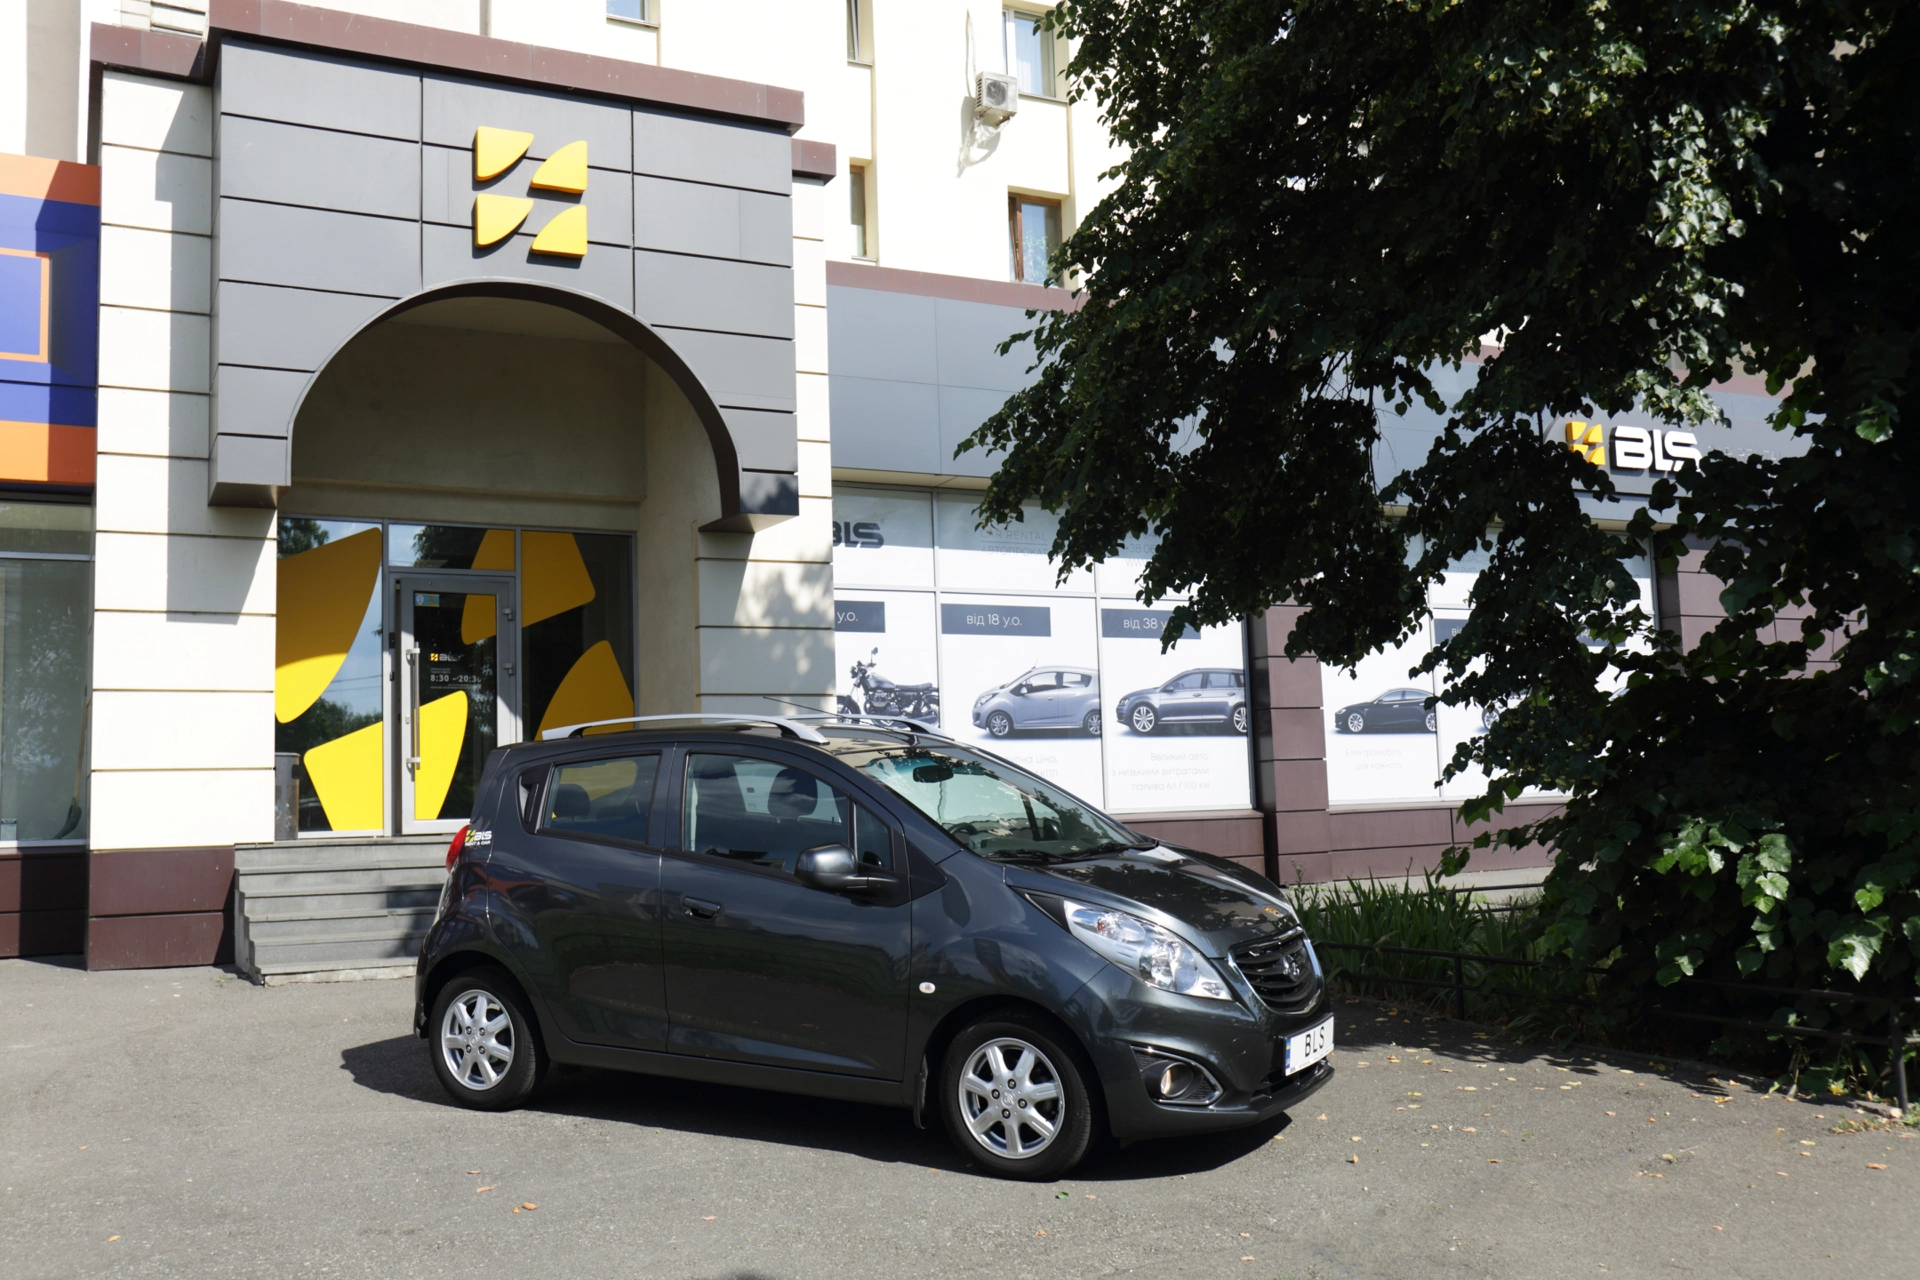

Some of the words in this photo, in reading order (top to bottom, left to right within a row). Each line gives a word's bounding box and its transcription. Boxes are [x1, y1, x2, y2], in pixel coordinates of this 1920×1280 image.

[1613, 425, 1703, 472] BLS
[980, 529, 1002, 540] CAR
[1006, 530, 1048, 542] RENTAL
[981, 545, 1048, 557] АВТОПРОКАТ
[836, 611, 858, 624] у.о.
[966, 612, 985, 627] від
[987, 613, 1000, 626] 18
[1003, 615, 1023, 628] у.о.
[1123, 617, 1140, 630] від
[1143, 617, 1158, 630] 38
[430, 674, 449, 682] 8:30
[1150, 752, 1187, 762] Великий
[1188, 752, 1209, 761] авто
[1345, 747, 1402, 757] Електромобіль
[1118, 768, 1160, 776] низькими
[1161, 767, 1210, 777] витратами
[1355, 763, 1369, 771] для
[1371, 762, 1402, 770] кожного
[1131, 782, 1165, 791] палива
[1184, 781, 1197, 789] 100
[474, 830, 492, 841] BLS
[1305, 1026, 1325, 1057] BLS
